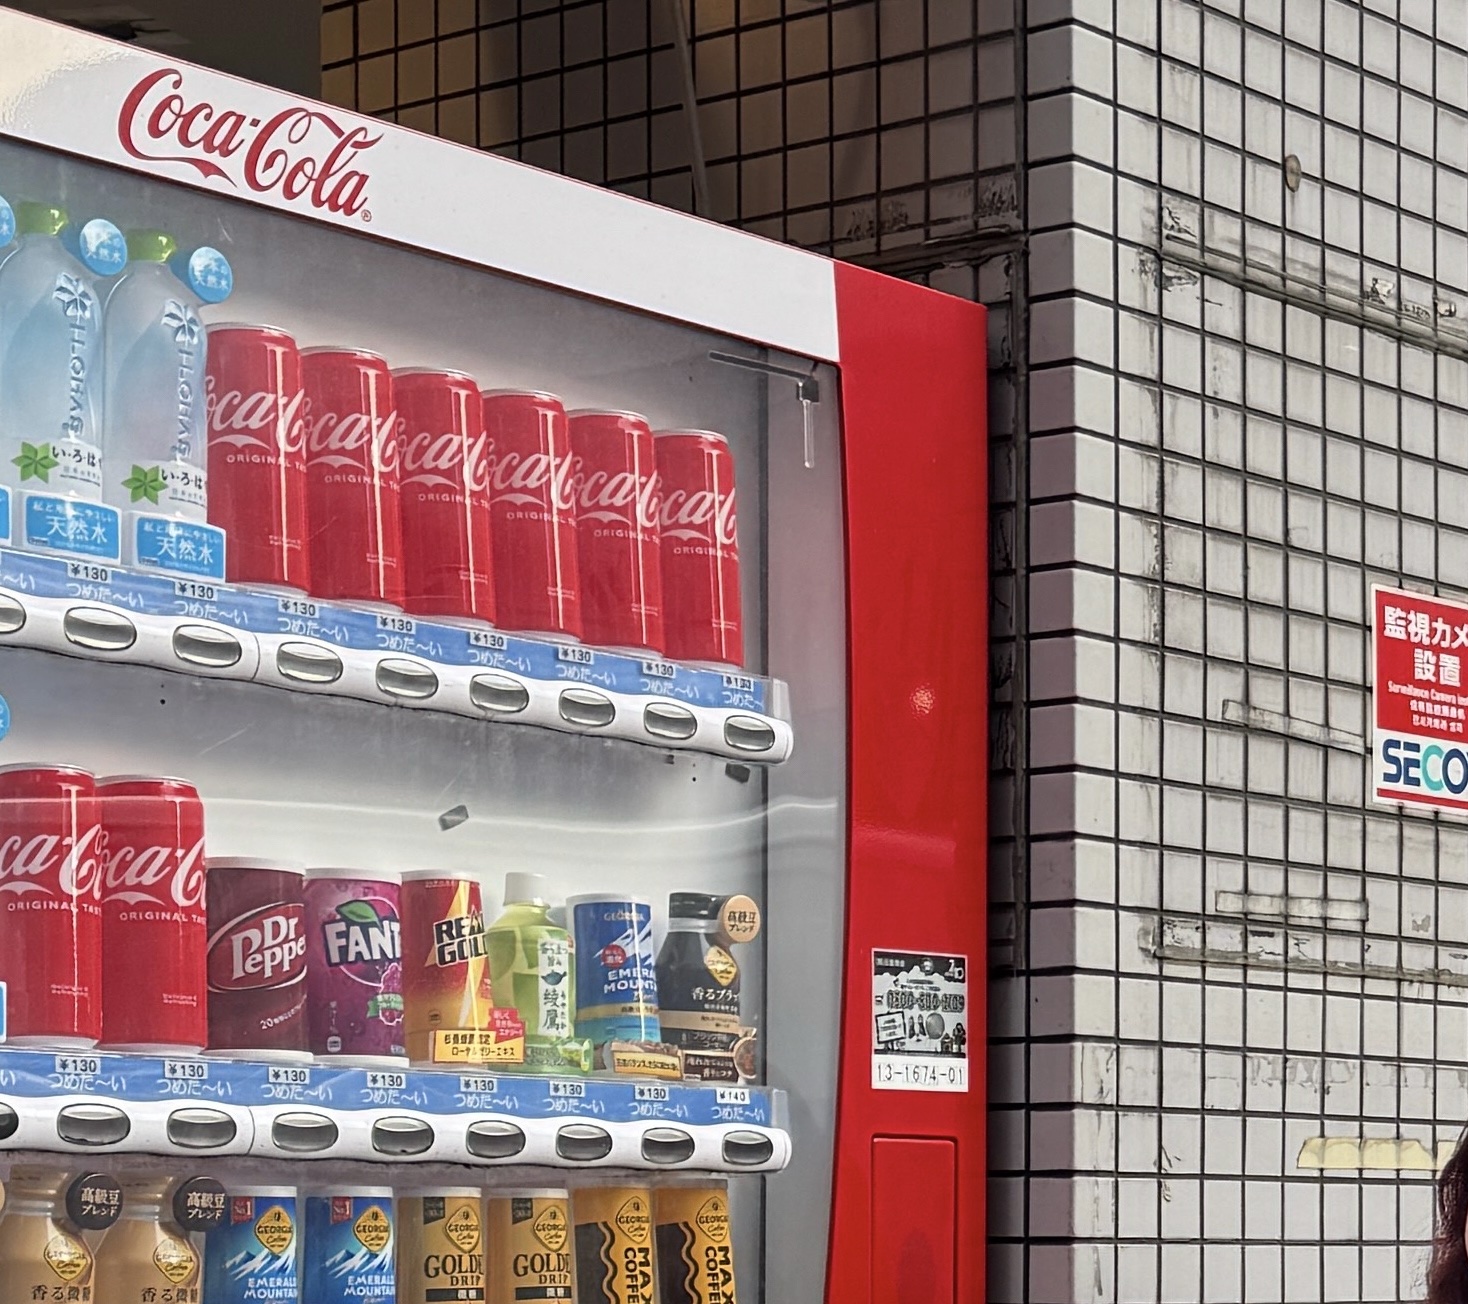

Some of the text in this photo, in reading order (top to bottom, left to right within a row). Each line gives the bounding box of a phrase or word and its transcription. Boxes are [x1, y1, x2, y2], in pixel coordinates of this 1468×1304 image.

[118, 67, 384, 219] Coca-Cola
[47, 516, 107, 544] 天然水
[158, 536, 212, 564] 天然水
[1414, 648, 1461, 687] 設置
[263, 915, 299, 949] Dr
[325, 920, 401, 964] FANT
[231, 928, 306, 980] Peppe
[542, 987, 559, 1031] 綾鷹
[877, 1064, 964, 1085] 13-1674-01
